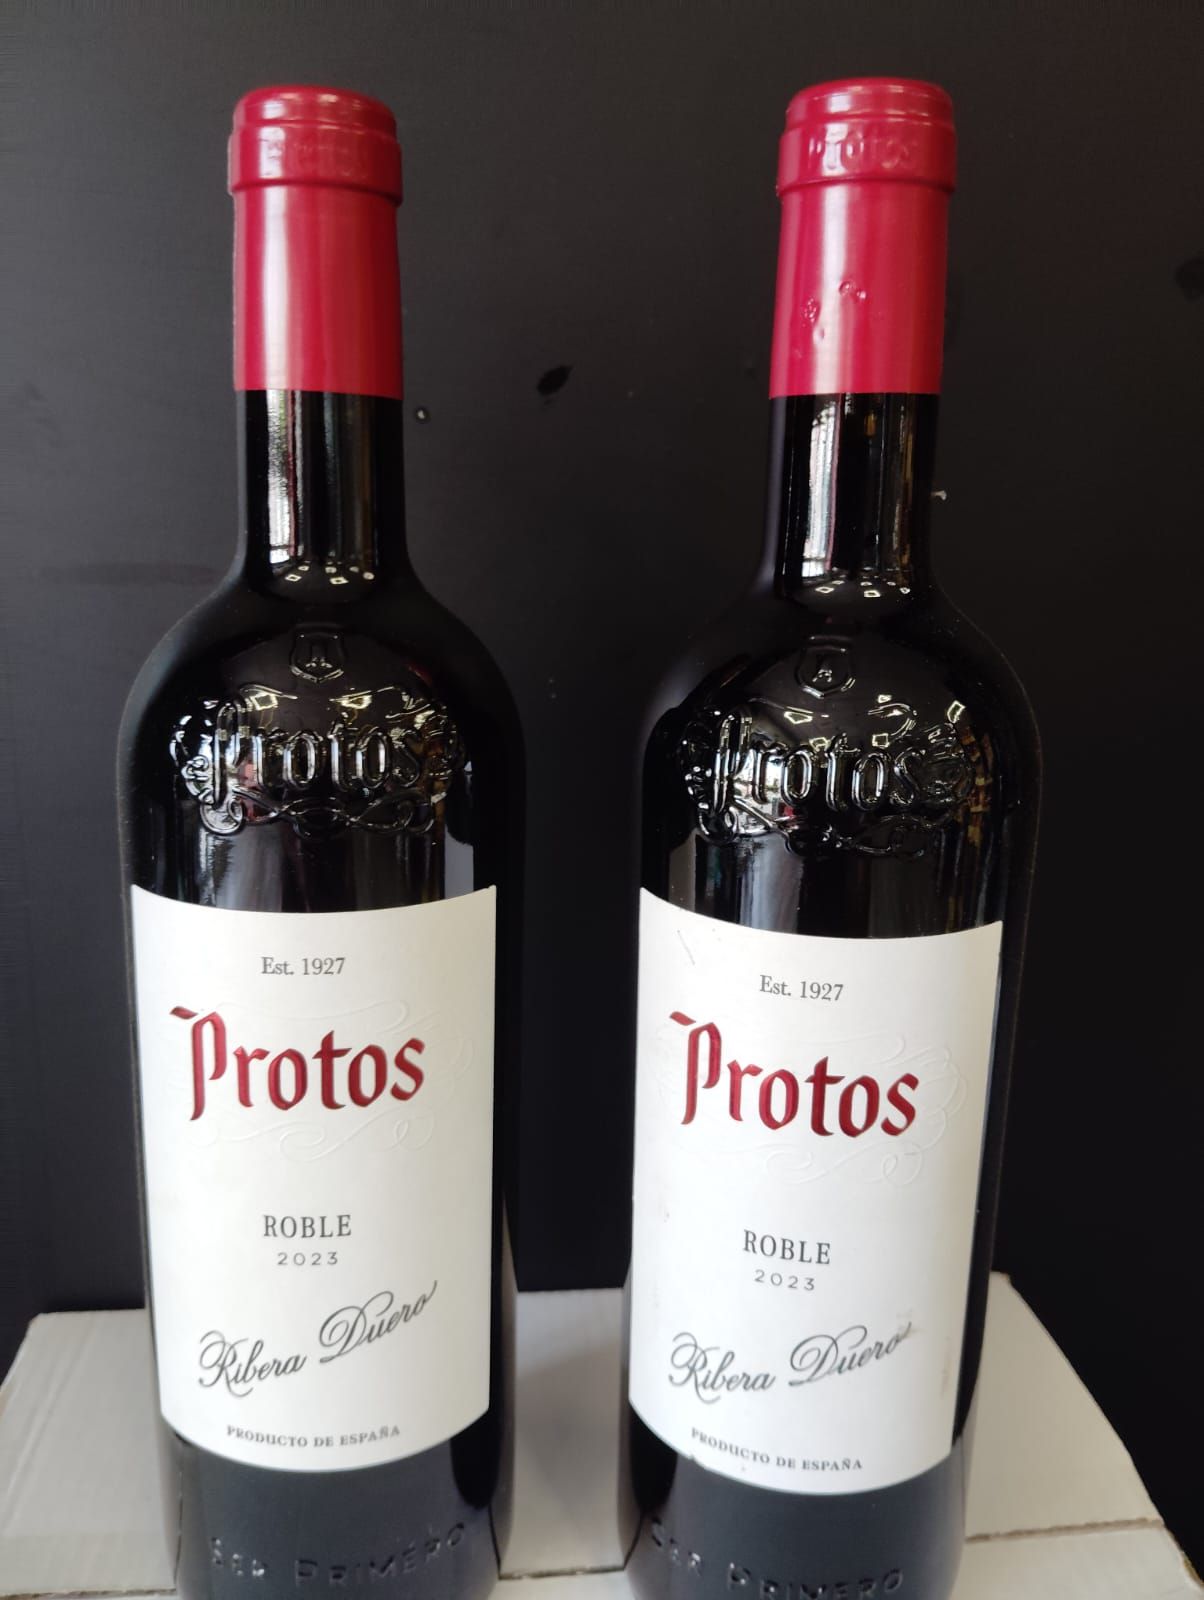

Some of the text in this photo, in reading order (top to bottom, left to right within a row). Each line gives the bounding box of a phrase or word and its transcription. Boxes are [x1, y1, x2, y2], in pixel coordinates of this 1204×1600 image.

[261, 956, 346, 976] Est. 1927
[759, 974, 844, 1002] Est. 1927
[169, 1005, 426, 1122] Protos
[669, 1011, 920, 1138] Protos
[263, 1214, 352, 1239] ROBLE
[277, 1251, 338, 1266] 2023
[743, 1229, 831, 1265] ROBLE
[754, 1269, 815, 1291] 2023
[198, 1280, 438, 1398] Ribera Duero
[668, 1321, 912, 1404] Ribera Duero
[227, 1424, 401, 1448] PRODUCTO DE ESPAÑA
[691, 1427, 863, 1471] PRODUCTO DE ESPAÑA
